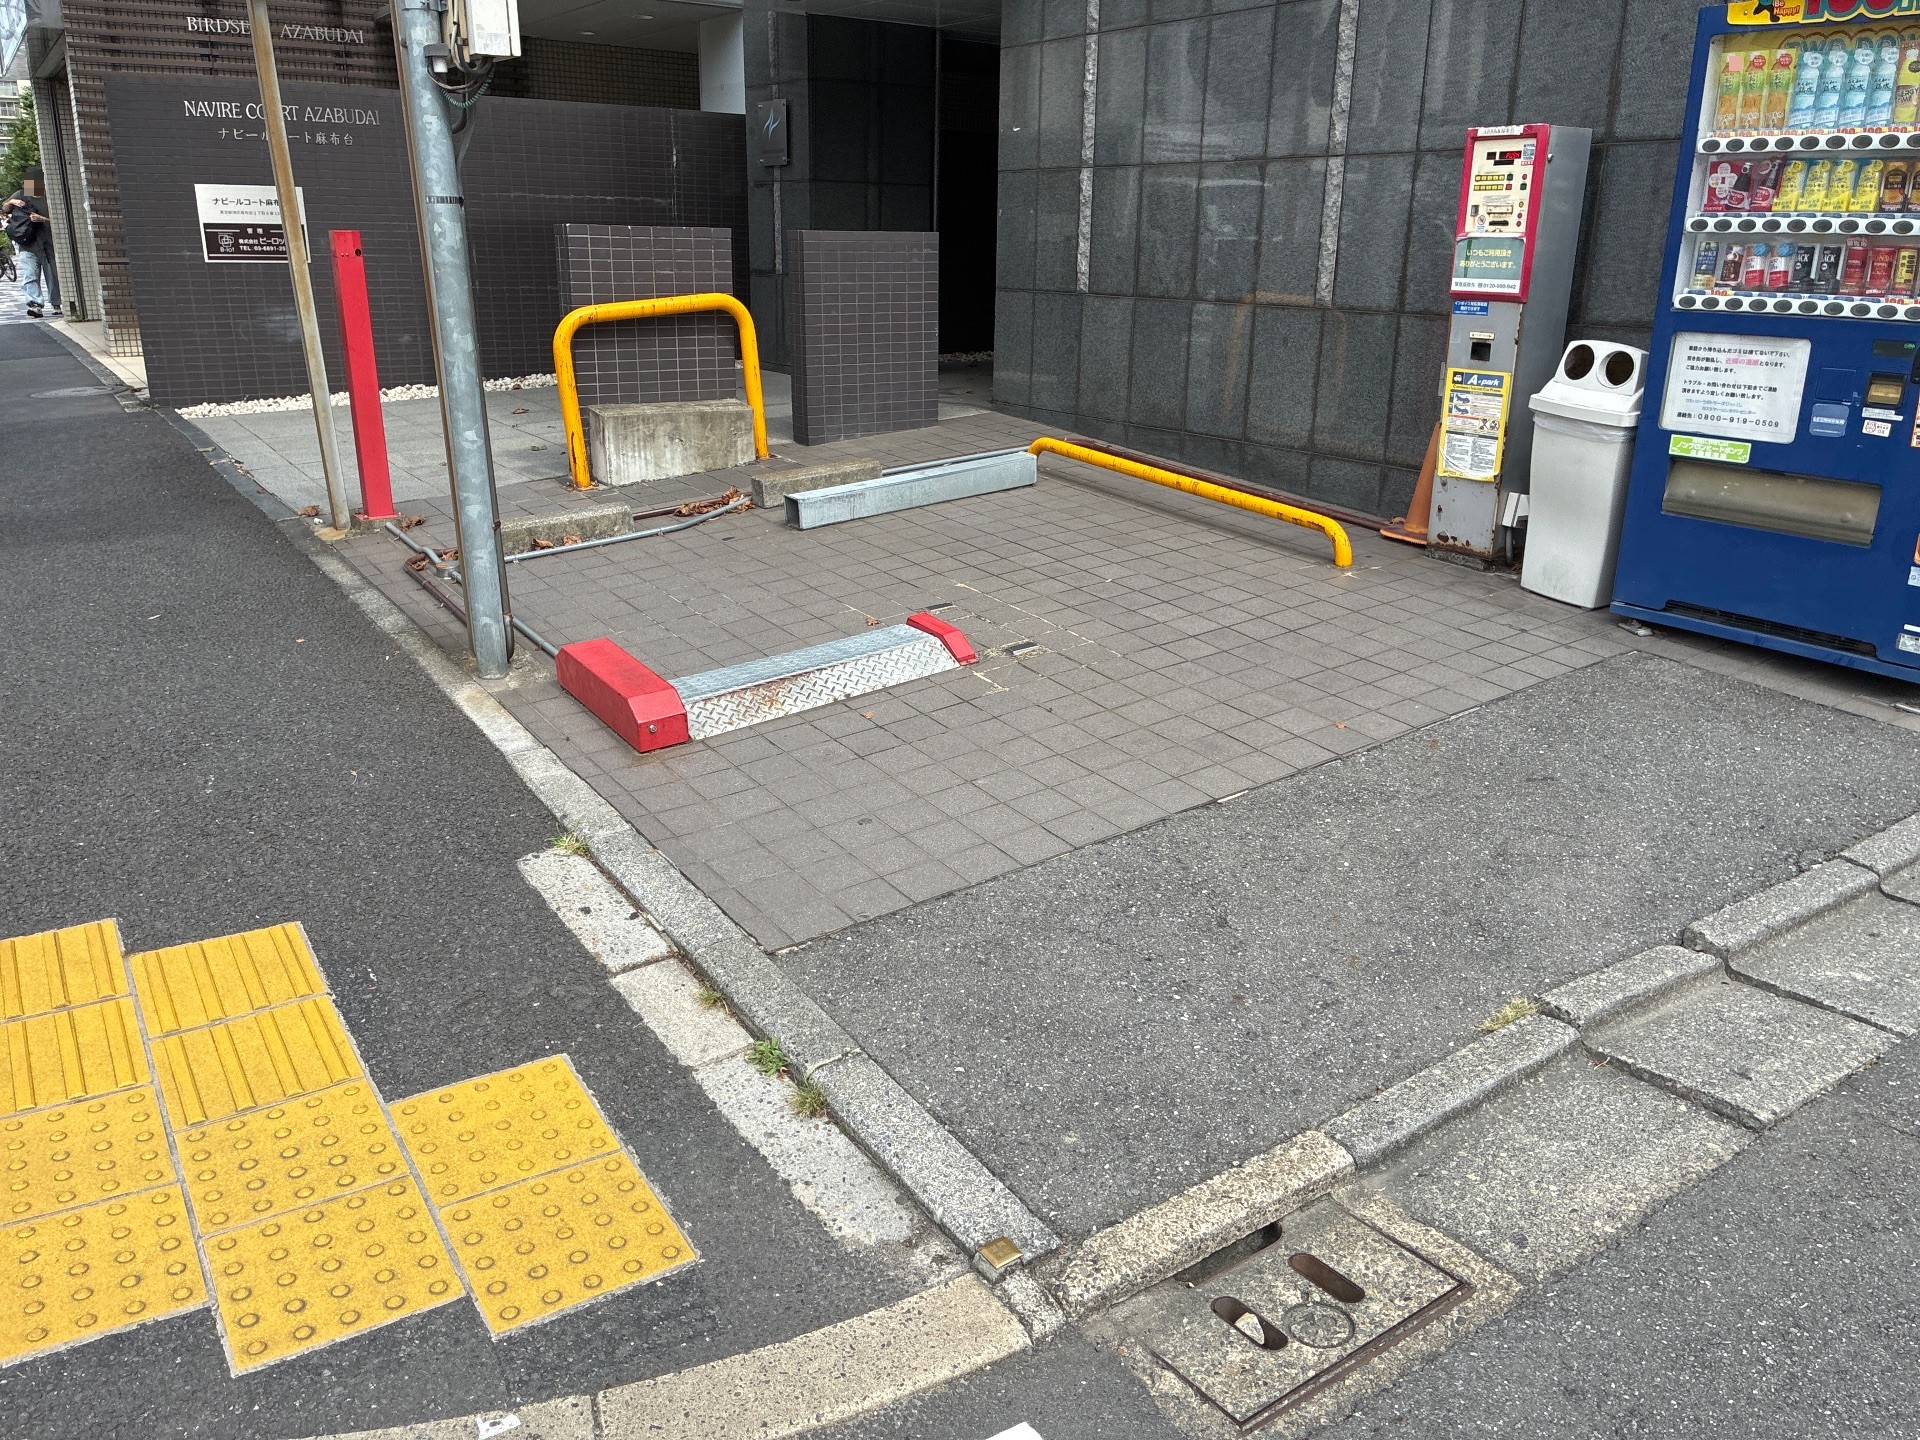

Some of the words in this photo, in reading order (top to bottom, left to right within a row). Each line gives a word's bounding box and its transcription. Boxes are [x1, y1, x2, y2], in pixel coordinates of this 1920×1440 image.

[280, 24, 364, 44] AZABUDAI
[183, 100, 242, 119] NAVIRE
[245, 103, 299, 121] CORT
[304, 106, 380, 126] AZABUDAI
[218, 127, 354, 146] ナビールート麻布台
[212, 197, 280, 206] ナビールコート麻布
